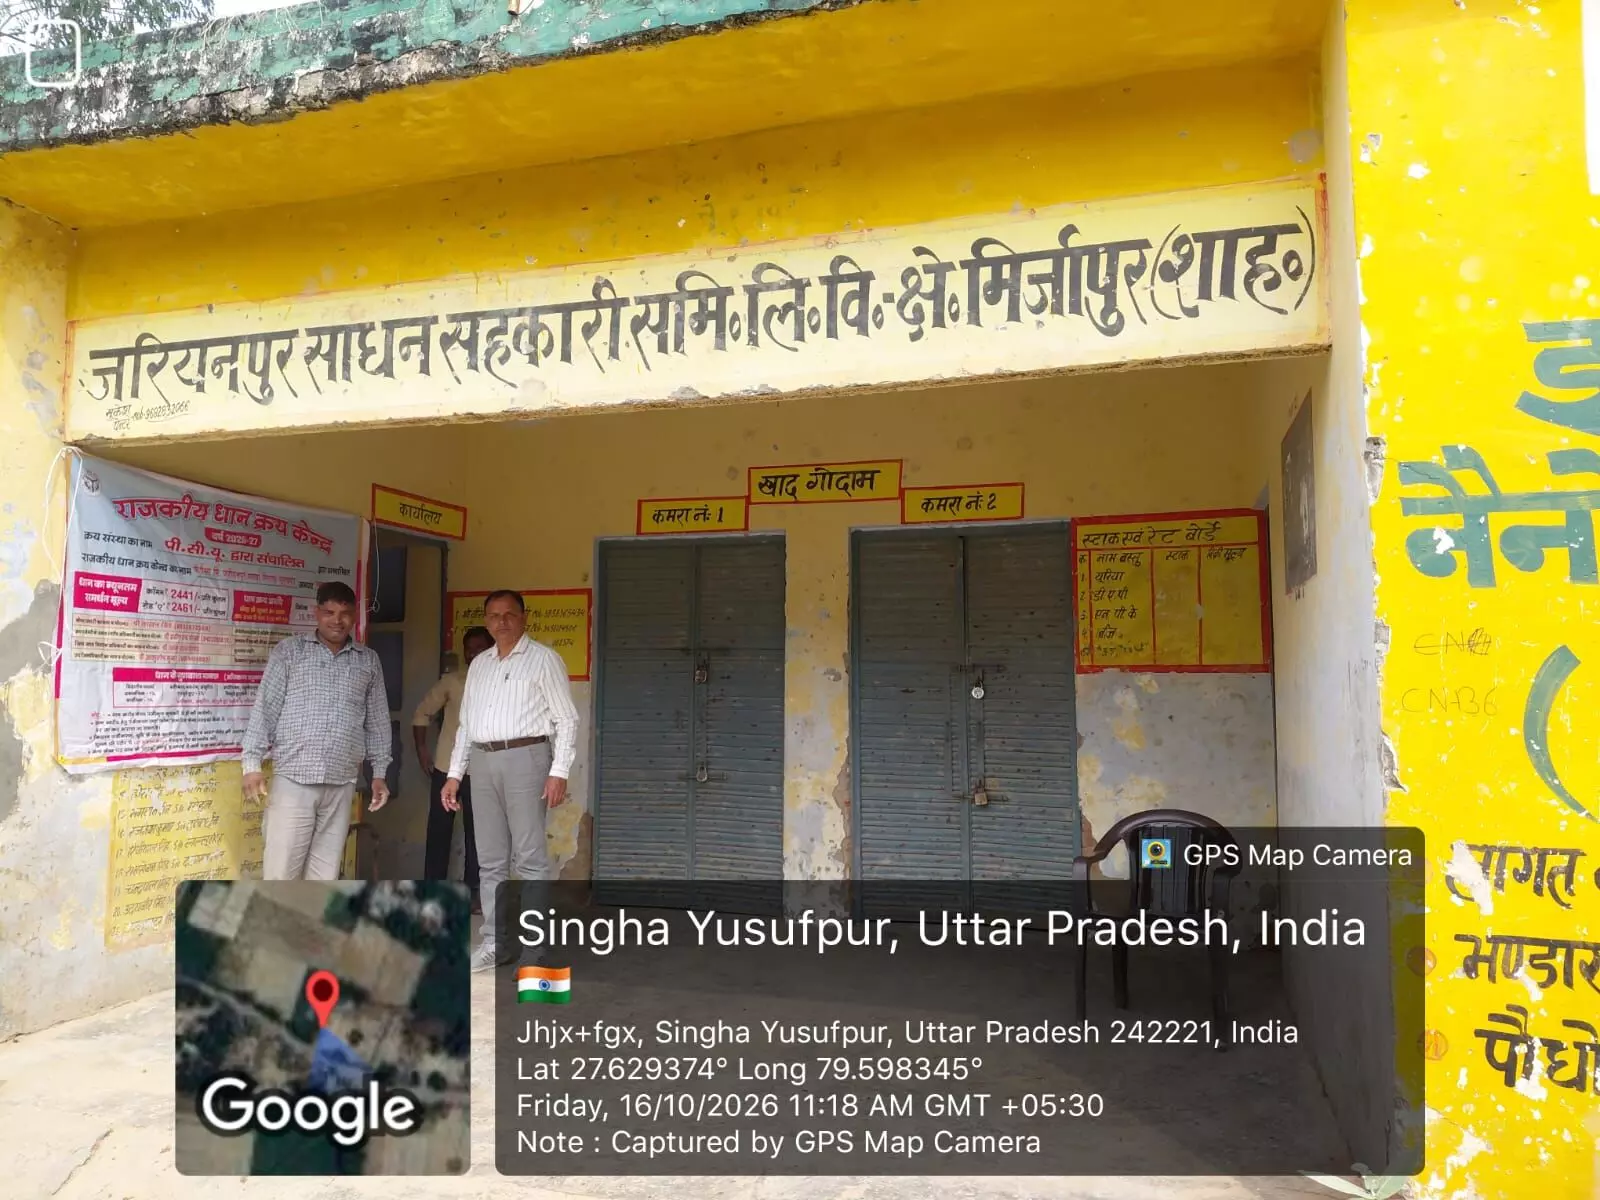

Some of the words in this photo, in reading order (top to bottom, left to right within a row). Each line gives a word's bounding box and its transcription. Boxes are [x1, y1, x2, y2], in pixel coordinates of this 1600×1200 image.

[439, 276, 630, 388] सहकारी
[758, 474, 800, 498] खाद
[806, 466, 880, 499] गोदाम
[399, 502, 443, 525] कार्यालय
[921, 495, 962, 516] कमरा
[987, 493, 997, 510] 2
[112, 492, 210, 521] राजकीय
[213, 502, 252, 527] धान
[254, 512, 288, 537] क्रय
[292, 520, 334, 556] केन्द्र
[652, 507, 691, 527] कमरा
[1148, 525, 1183, 545] रेट
[230, 550, 253, 562] द्वारा
[1095, 568, 1125, 583] यूरिया
